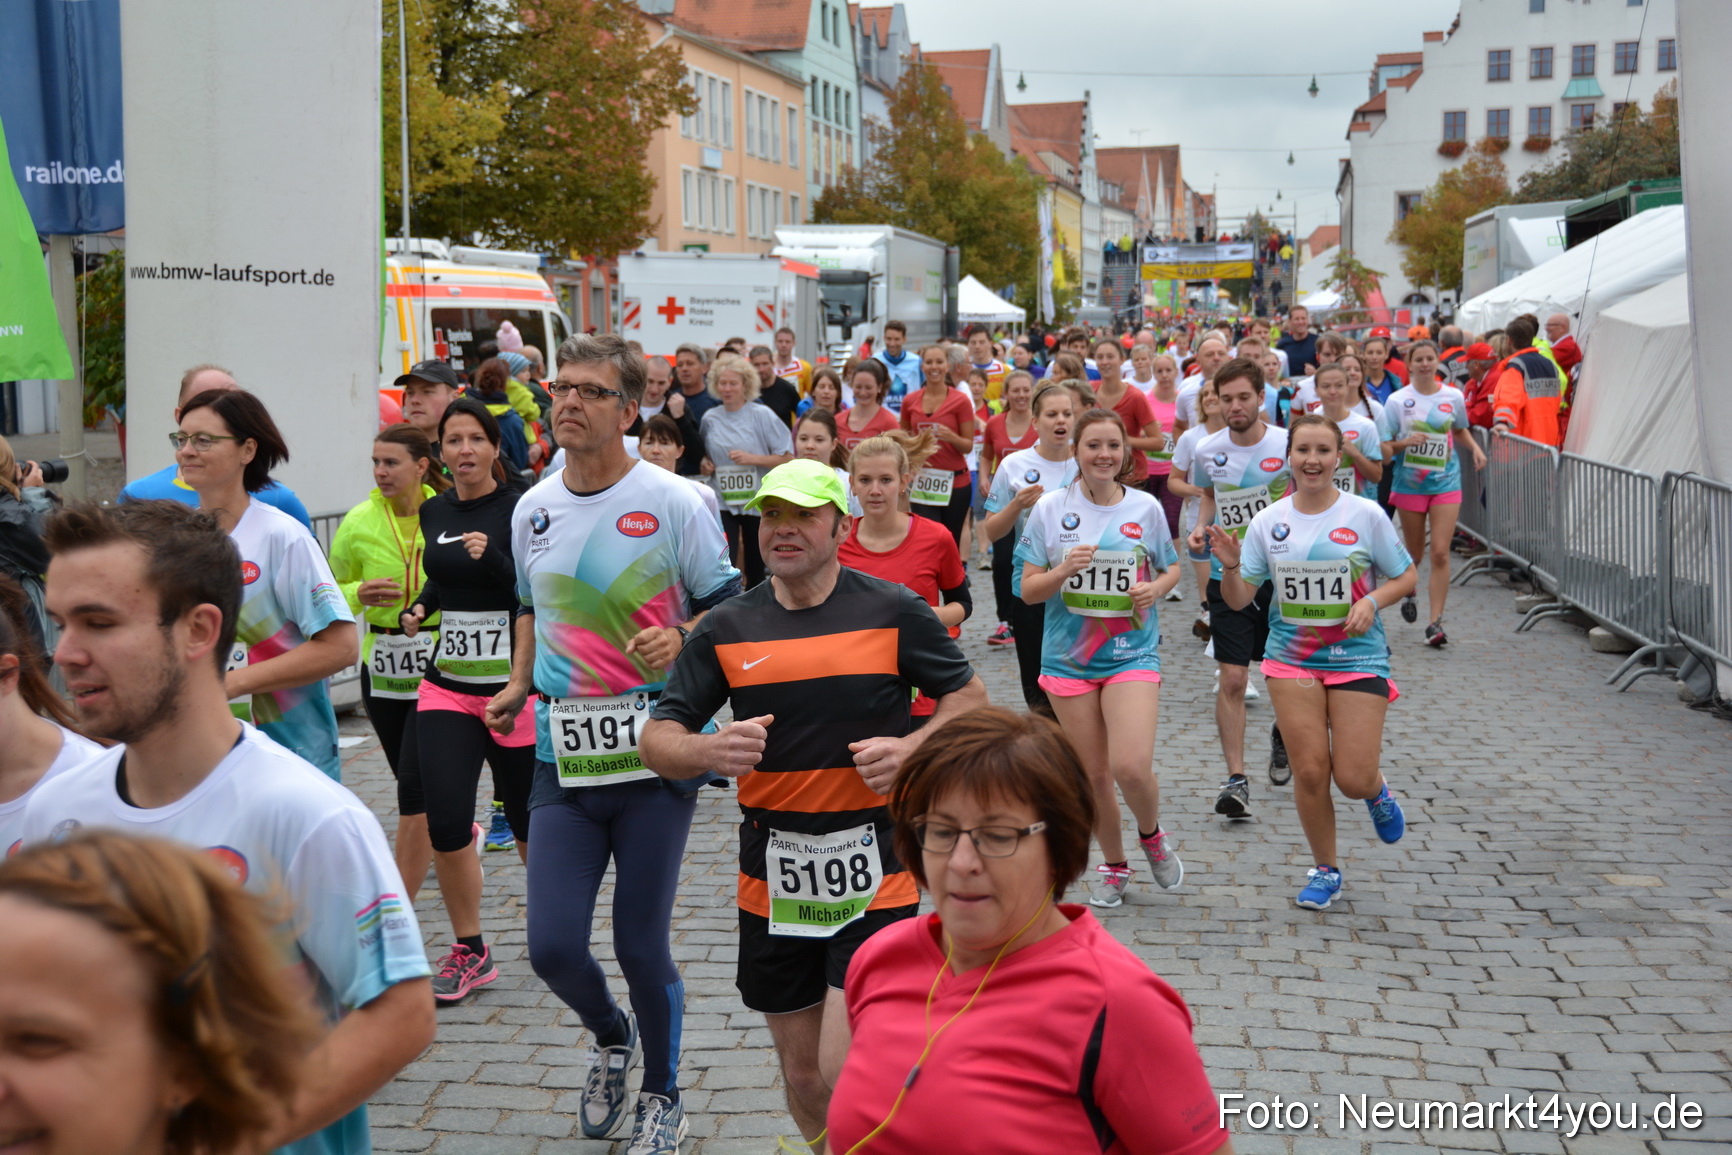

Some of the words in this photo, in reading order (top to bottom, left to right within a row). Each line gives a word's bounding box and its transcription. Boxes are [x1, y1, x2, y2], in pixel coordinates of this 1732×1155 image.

[25, 159, 125, 185] railone.d
[129, 262, 335, 287] www.bmw-laufsport.de
[1176, 266, 1215, 278] START
[689, 296, 741, 306] Bayerisches
[689, 307, 714, 316] Rotes
[689, 318, 714, 327] Kreuz
[720, 474, 753, 490] 5009
[917, 476, 949, 493] 5096
[1230, 491, 1258, 502] Neumarkt
[622, 517, 655, 531] Hervis
[1332, 531, 1355, 542] Hervis
[532, 538, 550, 548] PARTL
[1277, 566, 1300, 574] PARTL
[1302, 566, 1337, 574] Neumarkt
[1069, 567, 1130, 592] 5115
[1284, 577, 1345, 601] 5114
[1086, 597, 1109, 607] Lena
[1302, 607, 1326, 617] Anna
[458, 619, 495, 627] Neumarkt
[387, 640, 421, 649] Neumarkt
[445, 630, 502, 656] 5317
[1113, 636, 1131, 648] 16.
[1328, 645, 1347, 655] 16.
[375, 648, 429, 675] 5145
[386, 680, 419, 691] Monika
[552, 703, 581, 714] PARTL
[583, 701, 630, 712] Neumarkt
[561, 715, 638, 752] 5191
[562, 755, 642, 774] Kai-Sebastia
[771, 839, 802, 853] PARTL
[804, 840, 857, 854] Neumarkt
[779, 853, 873, 897] 5198
[799, 903, 855, 923] Michael
